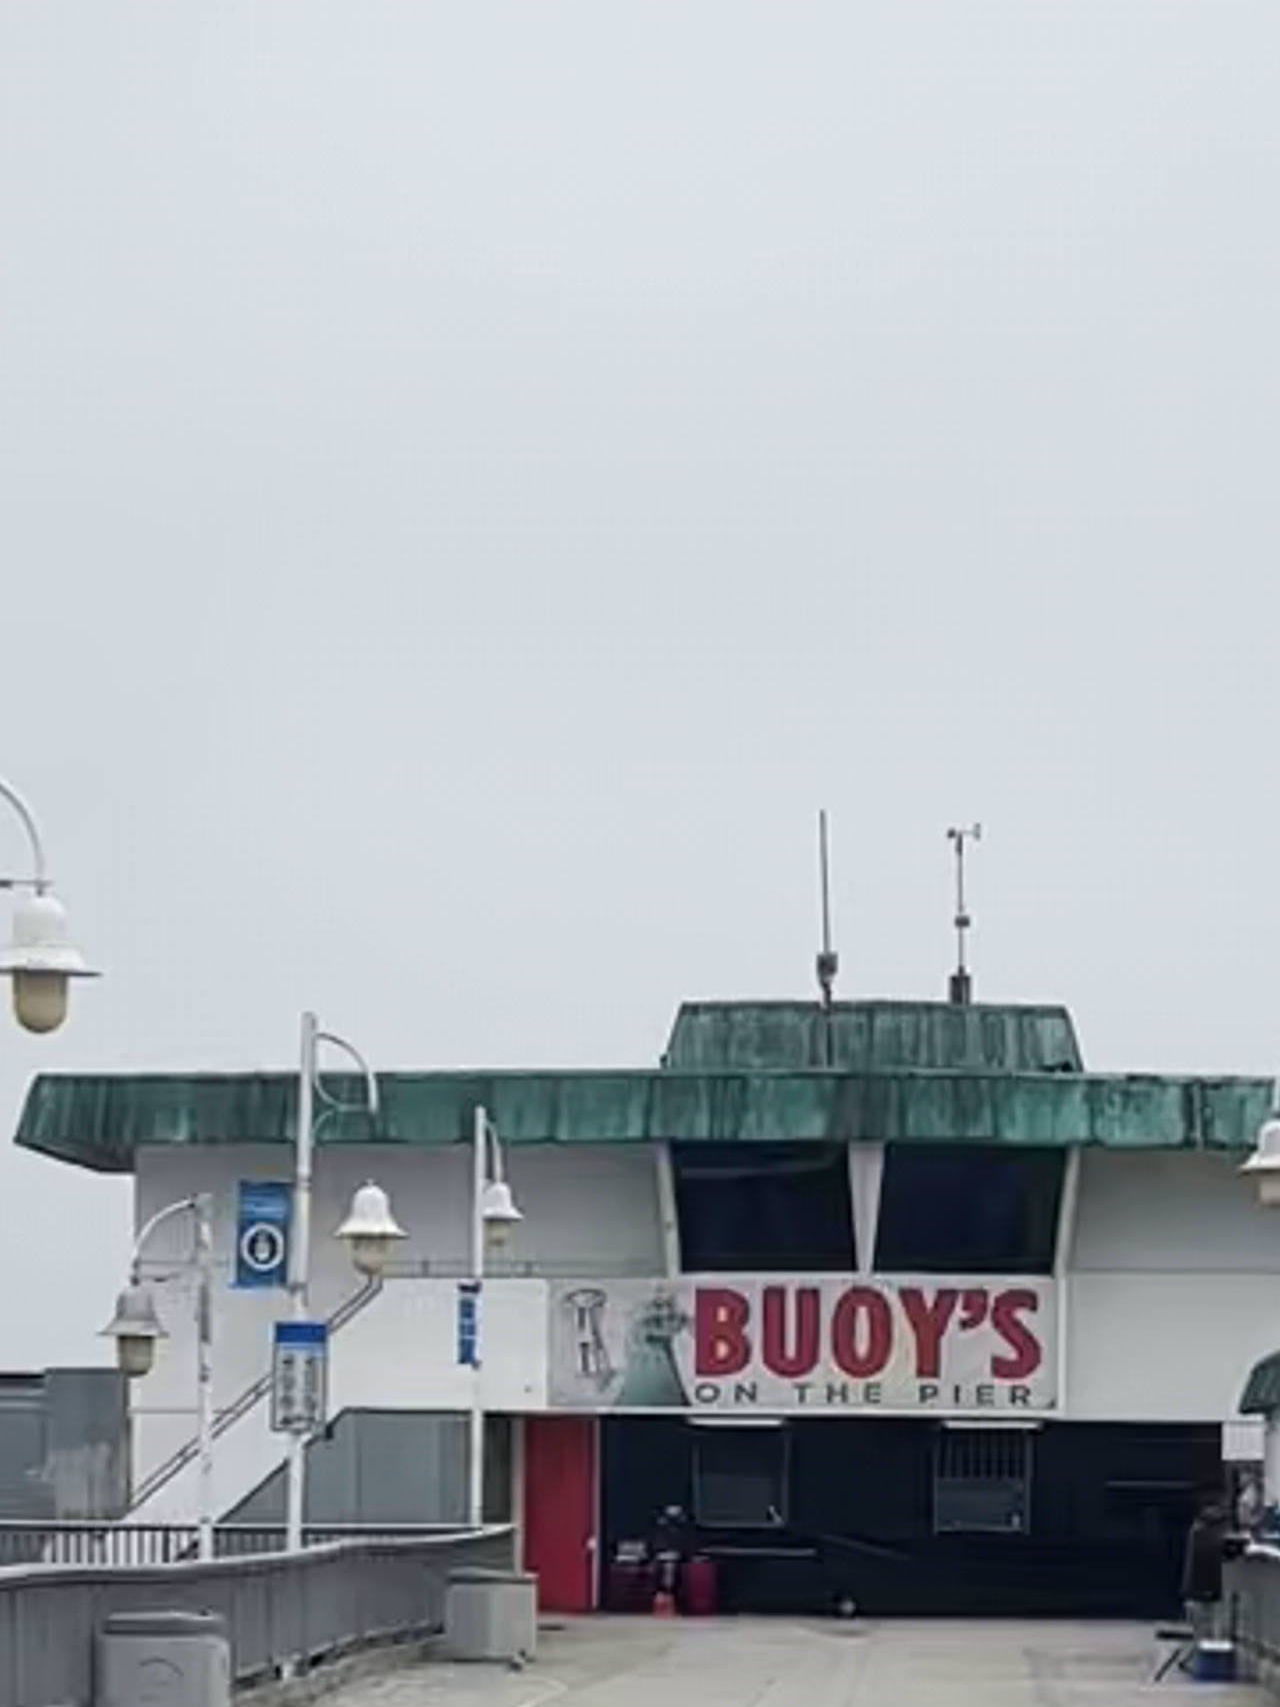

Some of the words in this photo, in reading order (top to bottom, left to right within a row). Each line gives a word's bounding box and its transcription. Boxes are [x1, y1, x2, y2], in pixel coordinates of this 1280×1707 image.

[695, 1285, 1041, 1380] BUOY'S
[694, 1383, 757, 1404] ON
[793, 1383, 883, 1404] THE
[919, 1384, 1033, 1405] PIER
